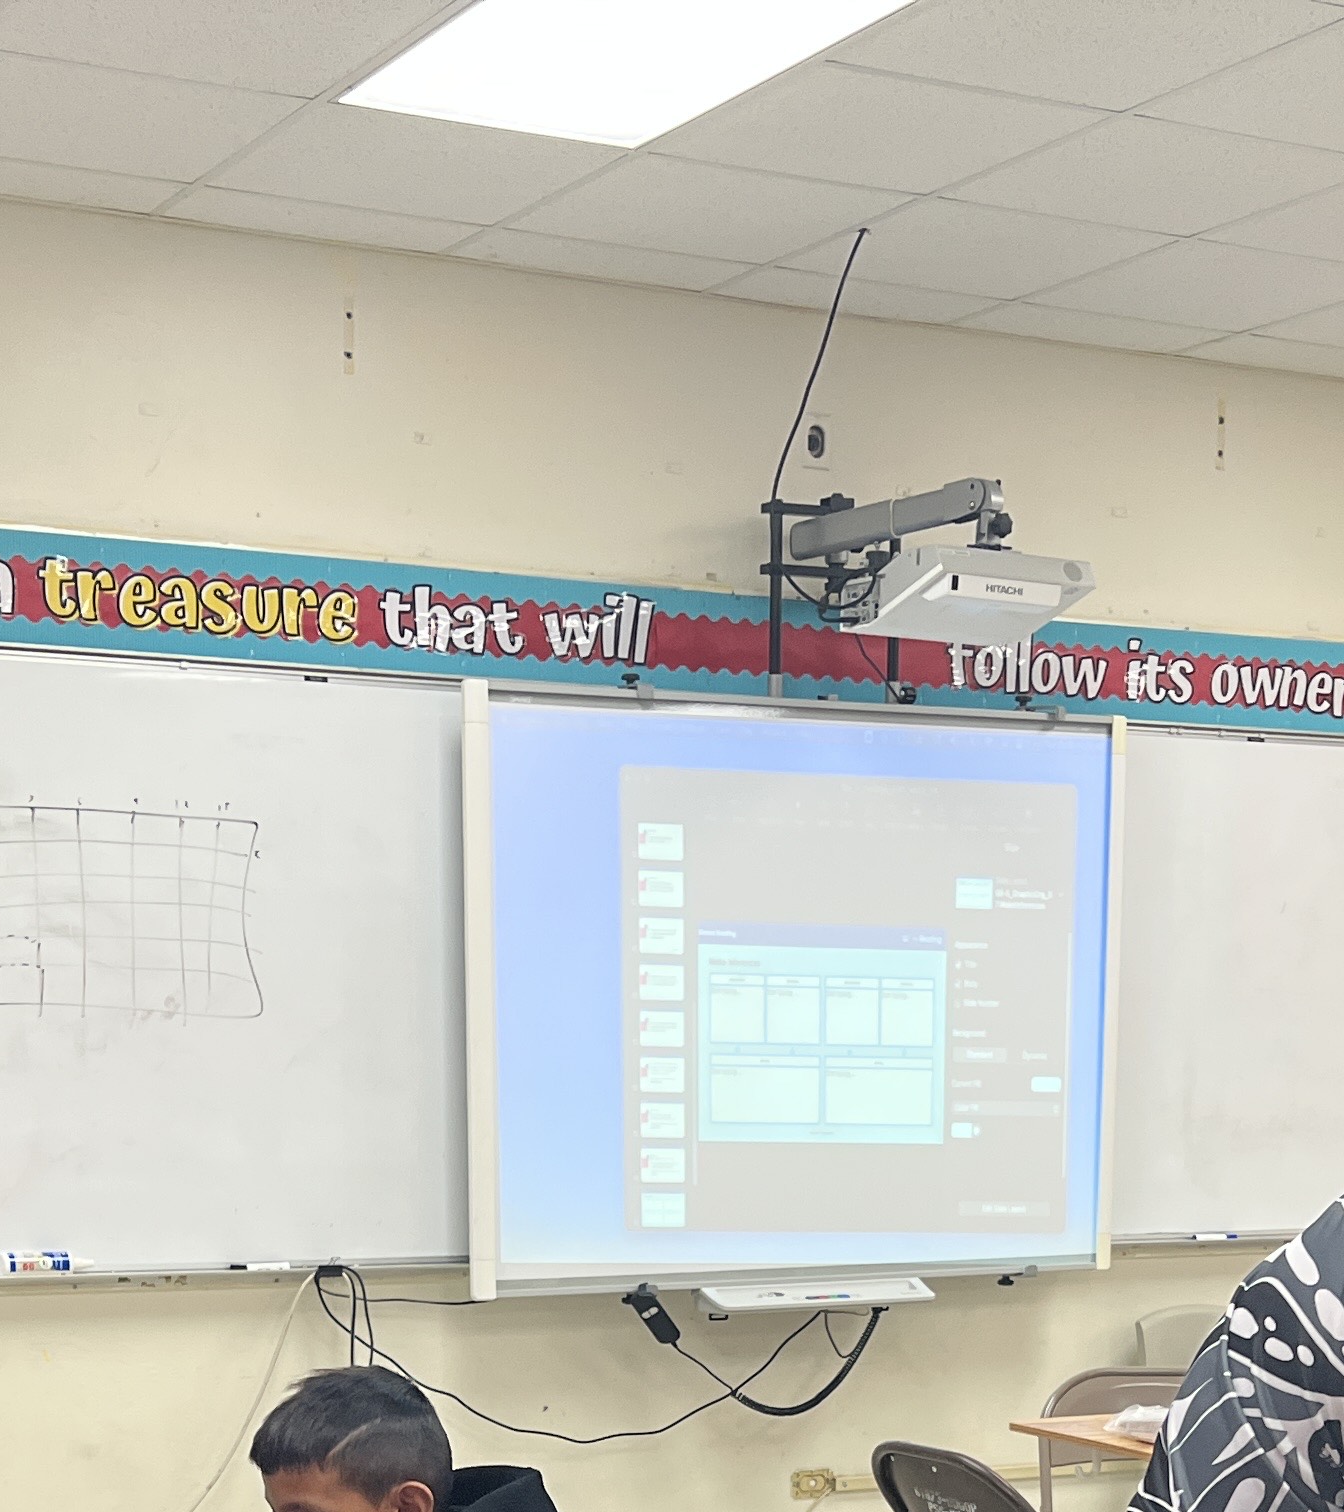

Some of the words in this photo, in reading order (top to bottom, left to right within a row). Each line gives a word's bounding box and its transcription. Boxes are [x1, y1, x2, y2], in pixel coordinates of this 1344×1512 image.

[40, 554, 359, 645] treasure
[378, 585, 526, 657] that
[542, 591, 657, 665] will
[947, 641, 1109, 700] follow
[1125, 638, 1194, 703] its
[985, 583, 1024, 596] HITACHI
